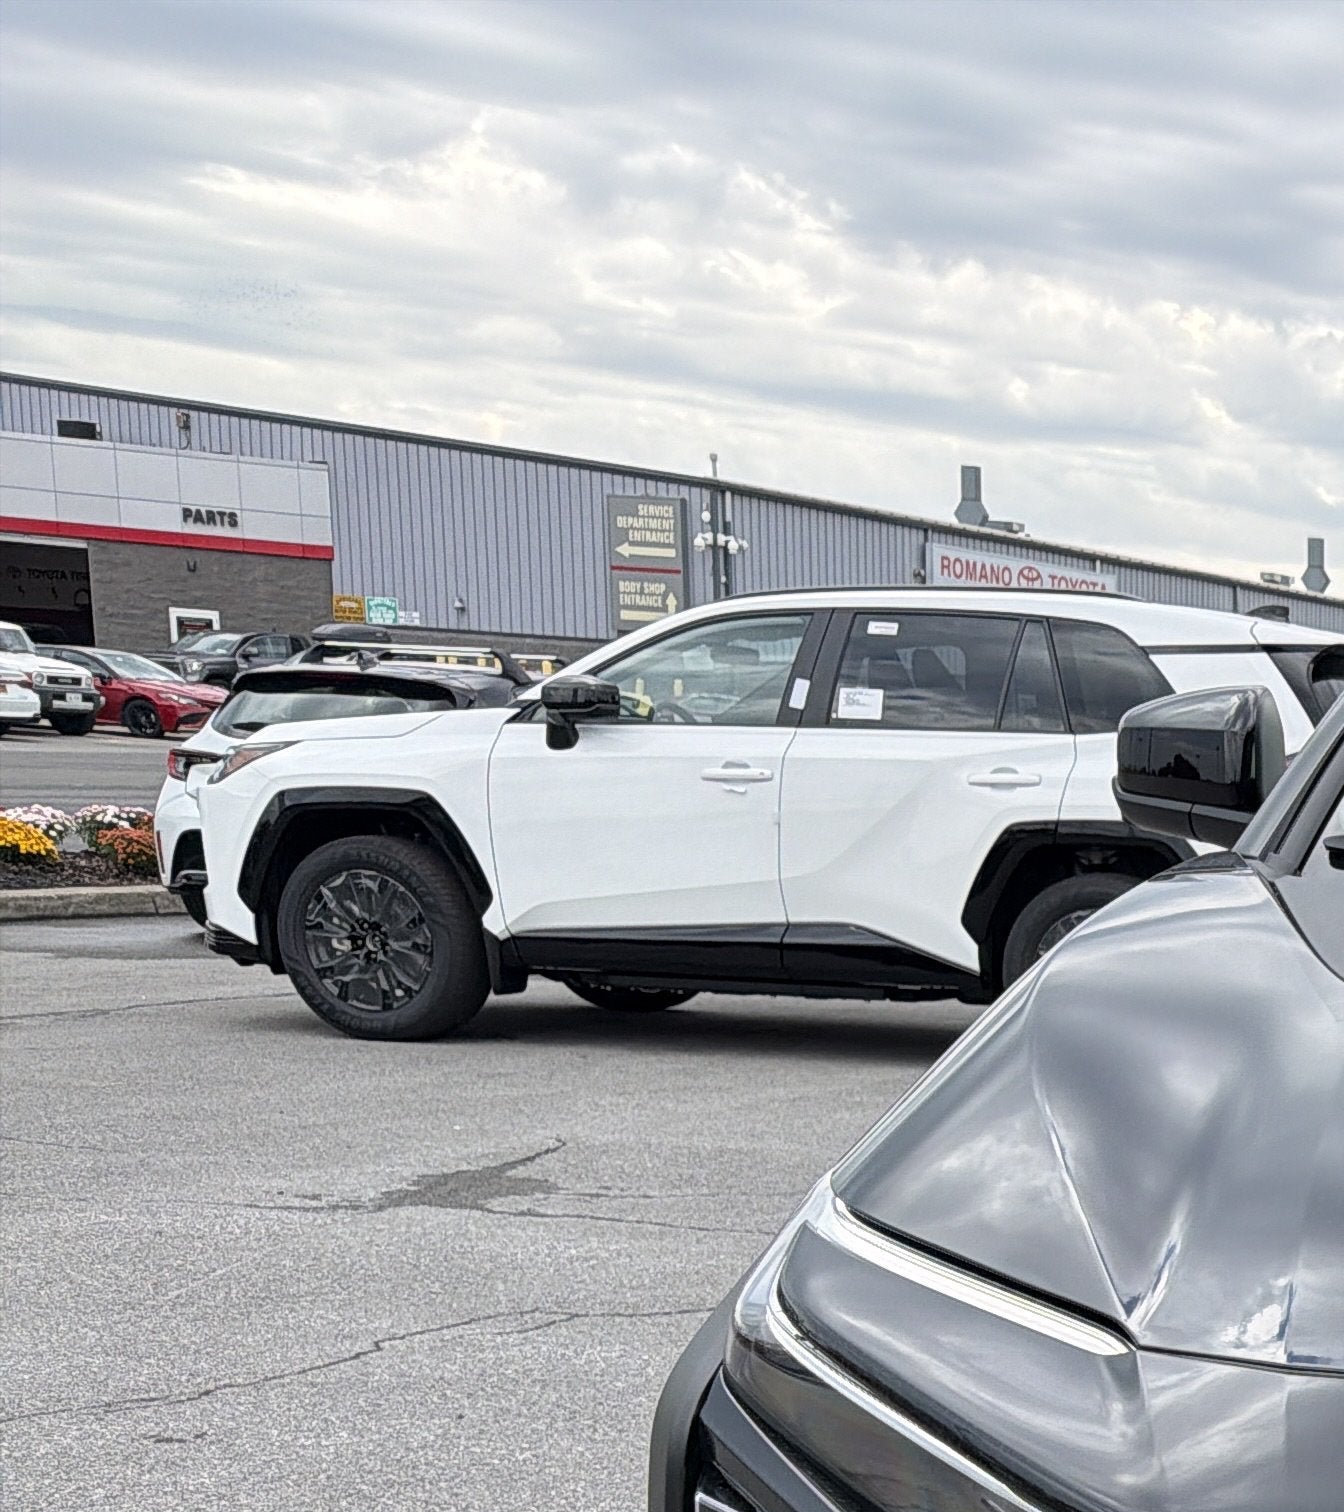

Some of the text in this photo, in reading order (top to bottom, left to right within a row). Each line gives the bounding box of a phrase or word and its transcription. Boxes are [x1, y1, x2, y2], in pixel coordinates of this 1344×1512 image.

[182, 507, 239, 528] PARTS
[638, 504, 674, 518] SERVICE
[616, 516, 675, 531] DEPARTMENT
[628, 529, 675, 544] ENTRANCE
[940, 555, 1013, 587] ROMANO
[619, 580, 666, 595] BODY SHOP
[620, 594, 662, 608] ENTRANCE
